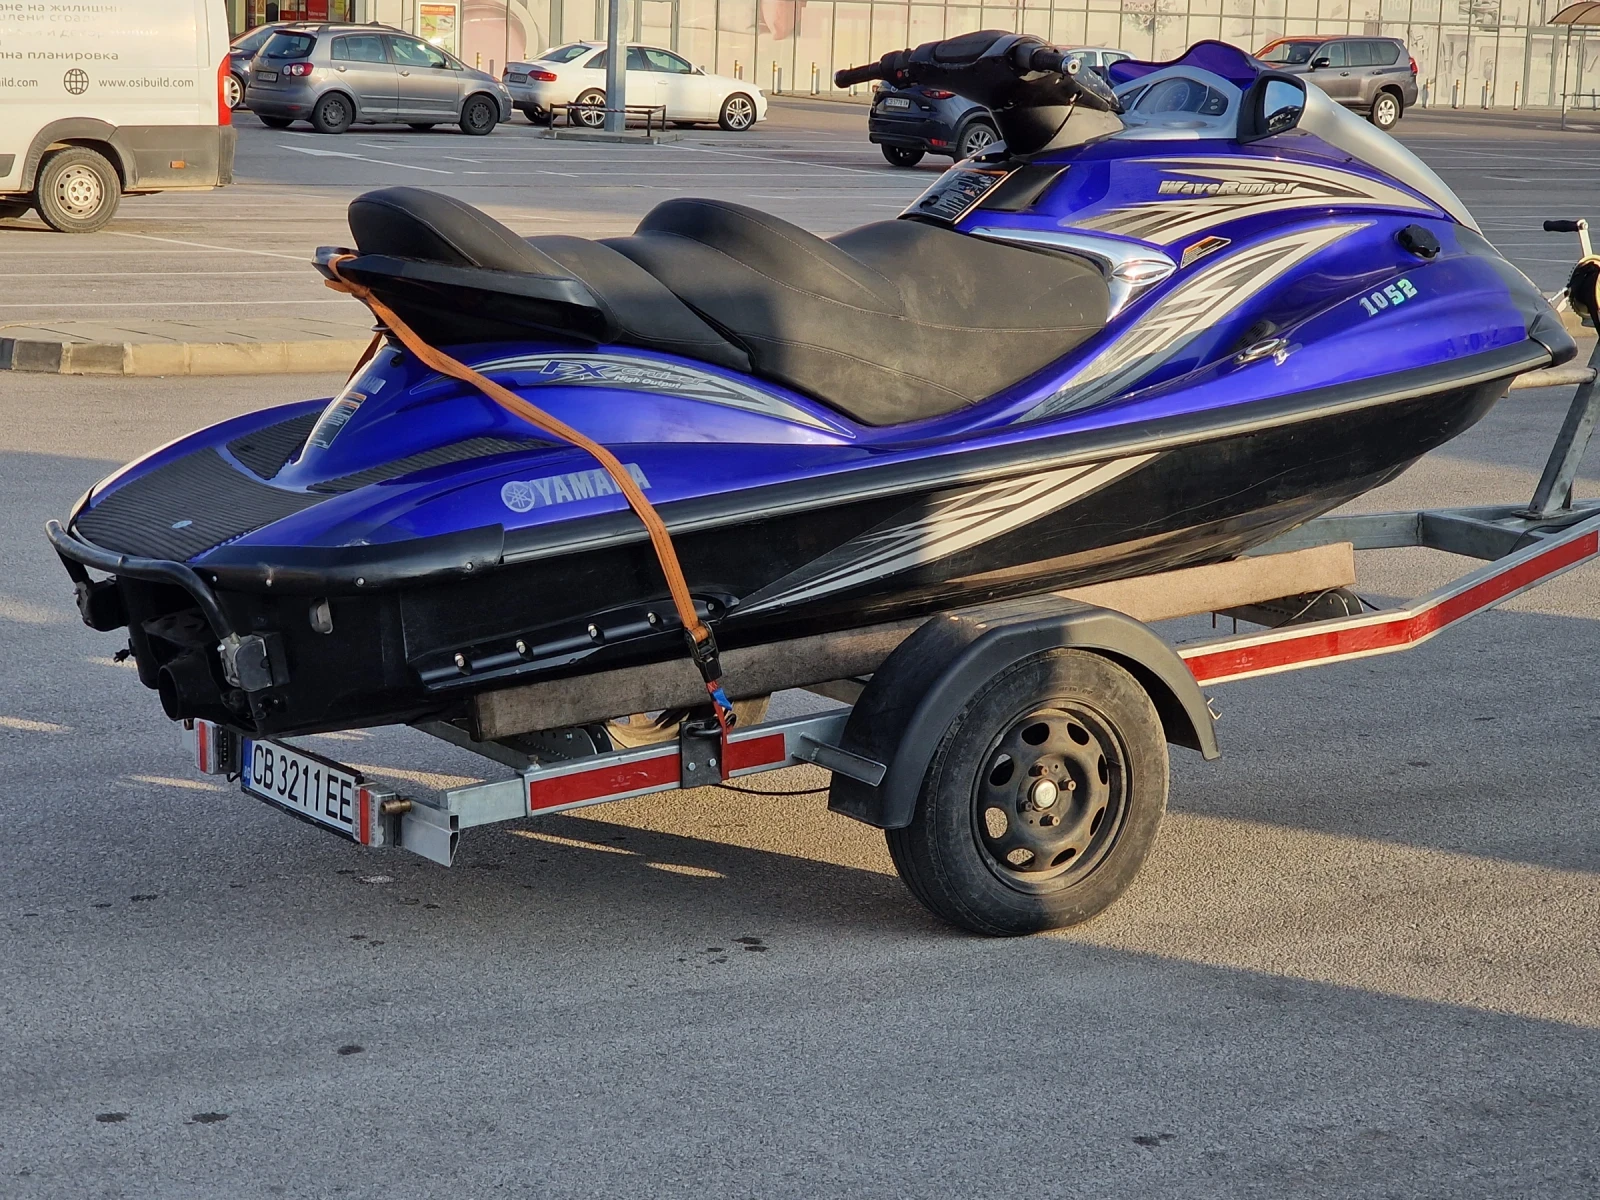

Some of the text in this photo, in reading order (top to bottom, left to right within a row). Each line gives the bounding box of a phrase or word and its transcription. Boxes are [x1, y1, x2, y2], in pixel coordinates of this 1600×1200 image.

[28, 4, 45, 12] на
[28, 52, 119, 62] планировка
[98, 78, 194, 88] www.osibuild.com
[1158, 180, 1300, 195] WaveRunner
[1359, 278, 1418, 317] 1052
[540, 360, 607, 379] FX
[614, 375, 681, 388] High Output
[532, 463, 651, 505] YAMAA
